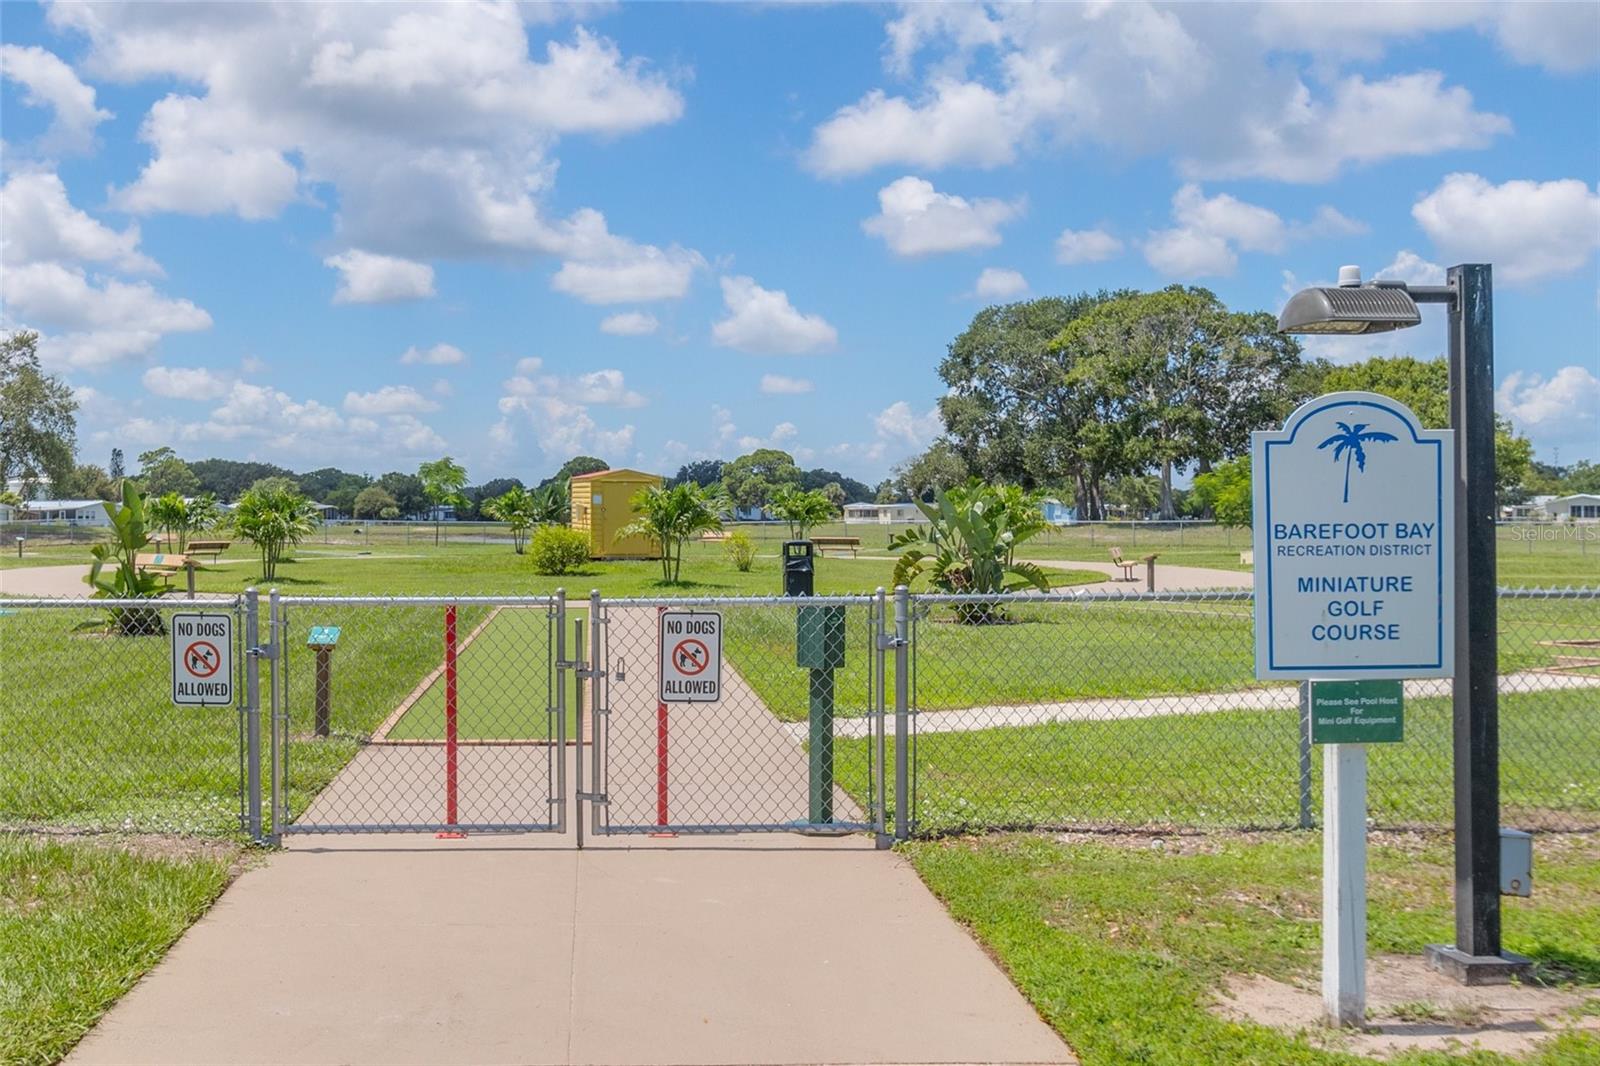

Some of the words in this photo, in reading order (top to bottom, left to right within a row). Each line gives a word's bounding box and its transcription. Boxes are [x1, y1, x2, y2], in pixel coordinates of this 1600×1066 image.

[1274, 523, 1389, 540] BAREFOOT
[1395, 523, 1435, 539] BAY
[1276, 545, 1365, 557] RECREATION
[1370, 544, 1432, 556] DISTRICT
[1298, 576, 1413, 592] MINIATURE
[1327, 600, 1384, 617] GOLF
[178, 623, 193, 636] NO
[196, 623, 226, 636] DOGS
[667, 620, 682, 634] NO
[686, 620, 716, 634] DOGS
[1312, 624, 1400, 641] COURSE
[177, 683, 228, 697] ALLOWED
[665, 680, 716, 694] ALLOWED
[1316, 698, 1343, 706] Please
[1344, 697, 1359, 705] See
[1360, 697, 1378, 705] Pool
[1379, 697, 1398, 705] Host
[1350, 707, 1364, 715] For
[1318, 717, 1334, 725] Mini
[1336, 717, 1353, 725] Golf
[1354, 716, 1397, 726] Equipment
